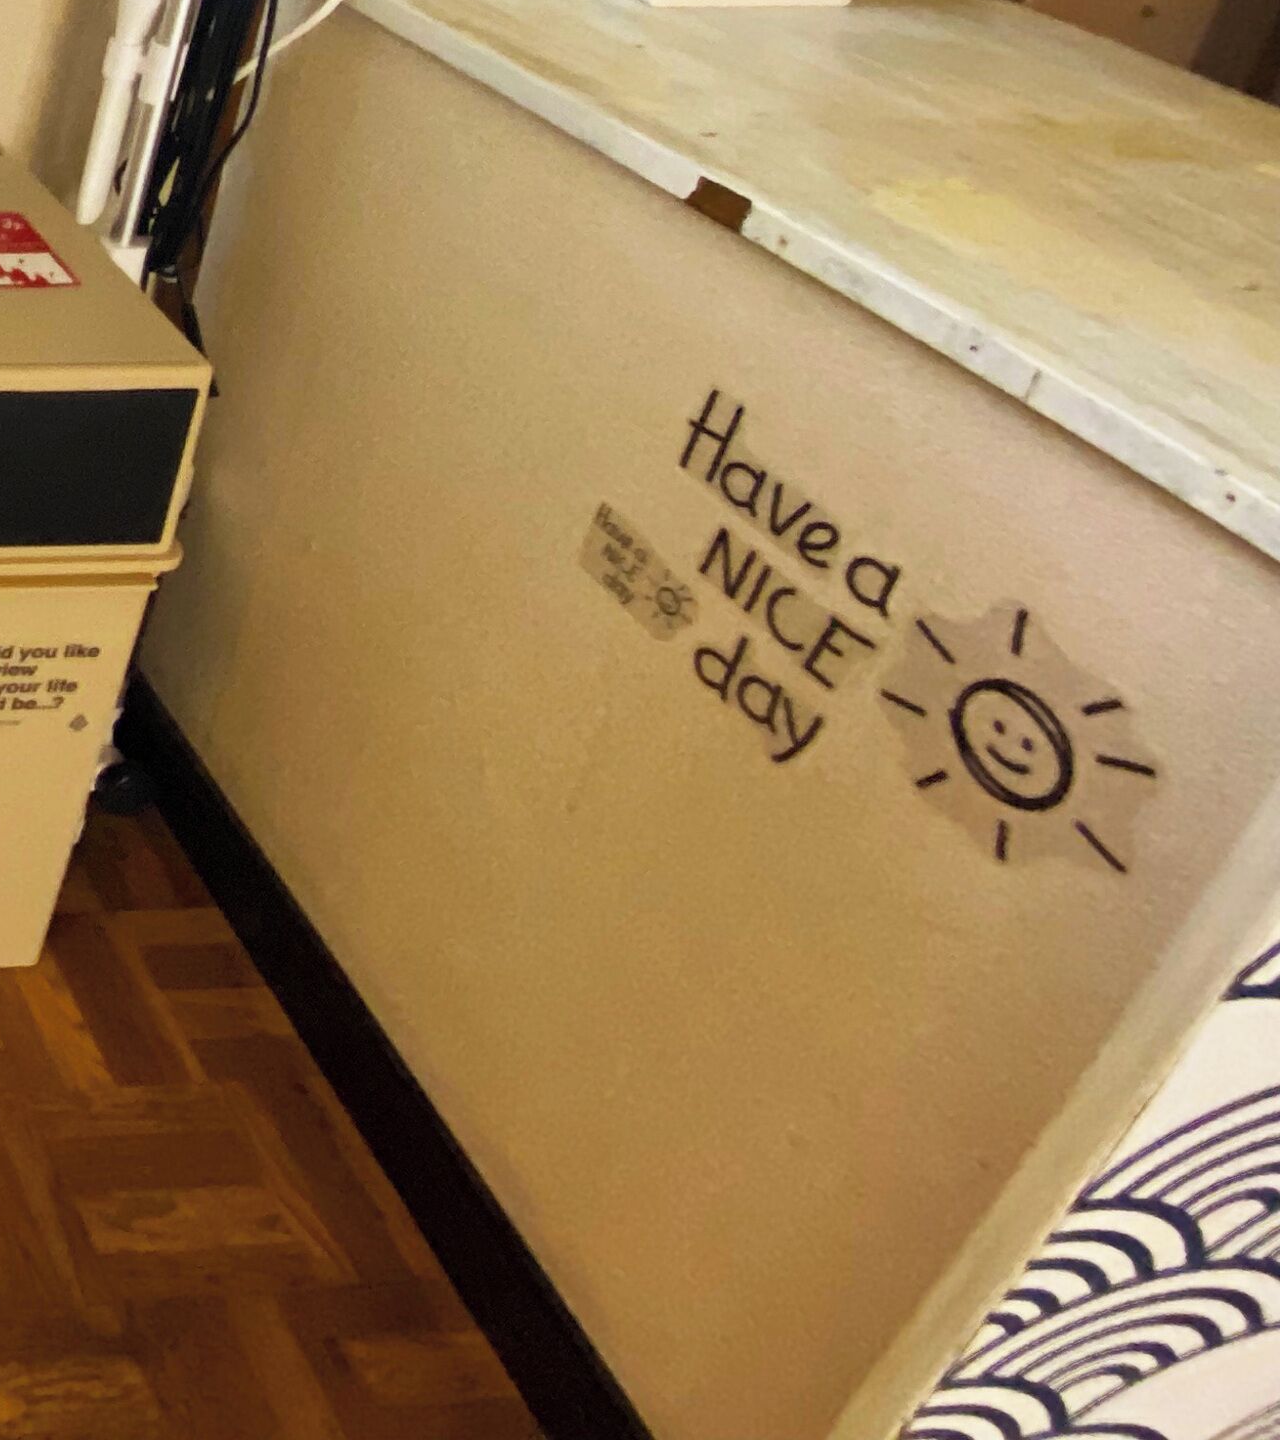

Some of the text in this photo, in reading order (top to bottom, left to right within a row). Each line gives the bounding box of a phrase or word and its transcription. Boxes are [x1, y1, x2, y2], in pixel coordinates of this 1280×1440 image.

[679, 389, 902, 619] Have a
[18, 646, 58, 663] you
[63, 643, 101, 659] like
[699, 527, 878, 690] NICE
[46, 678, 78, 693] life
[693, 635, 826, 763] day
